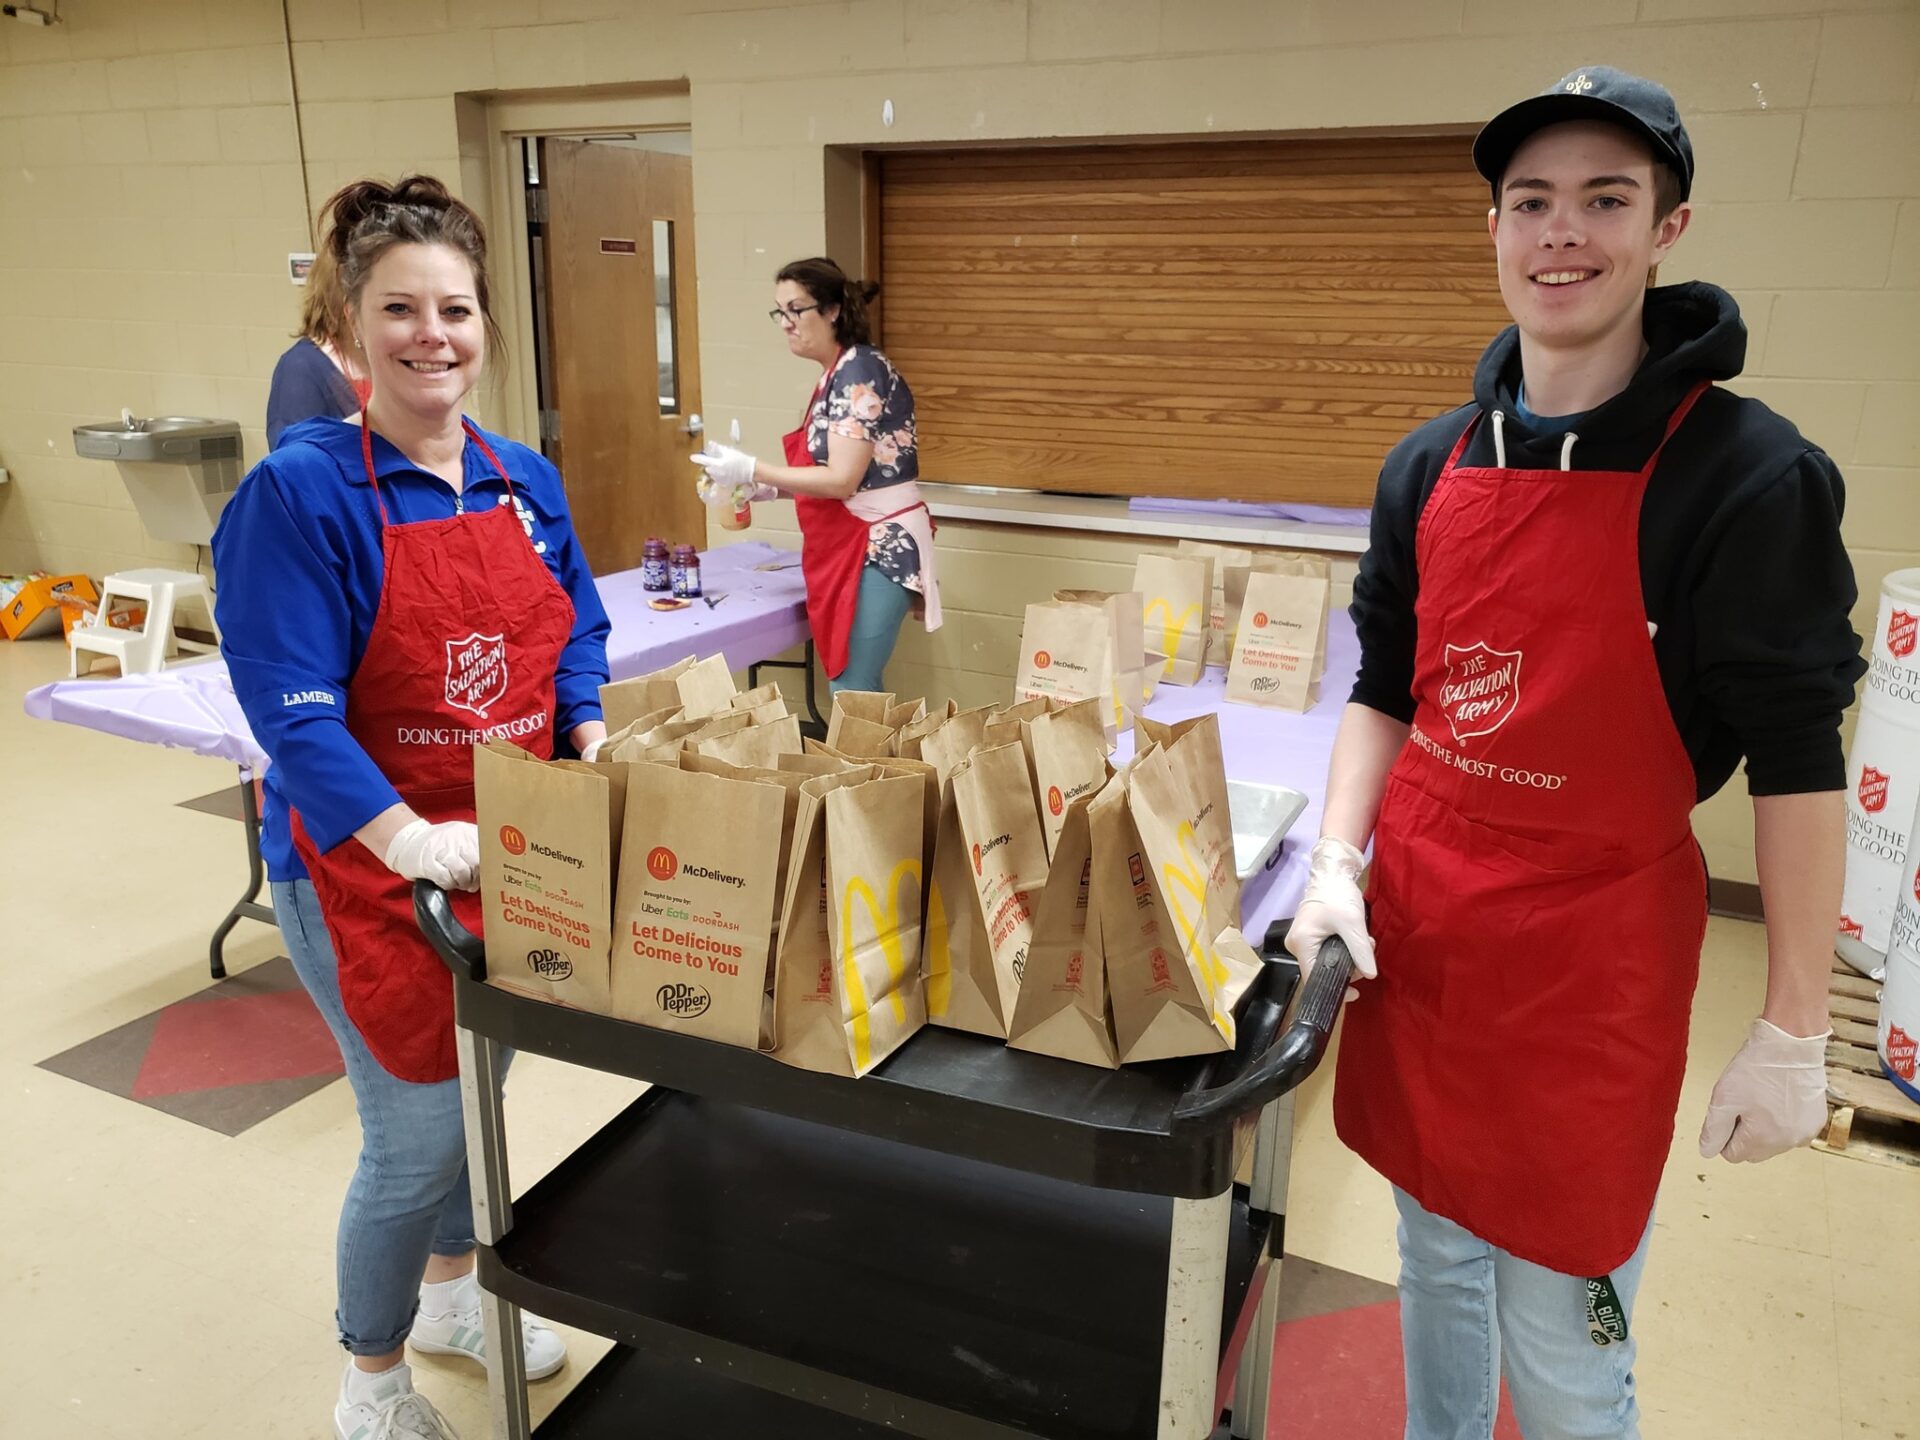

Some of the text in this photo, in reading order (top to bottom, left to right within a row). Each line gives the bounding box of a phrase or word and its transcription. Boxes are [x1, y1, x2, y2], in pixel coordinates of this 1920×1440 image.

[458, 641, 482, 670] THE
[1242, 657, 1296, 672] Come to You
[1243, 648, 1299, 662] Let Delicious
[1460, 655, 1486, 677] THE
[448, 642, 501, 698] SALVATION
[1443, 662, 1511, 707] SALVATION
[467, 665, 498, 706] ARMY
[1455, 691, 1508, 723] ARMY
[397, 728, 449, 745] DOING
[451, 728, 480, 745] THE
[1432, 741, 1452, 764] THE
[1454, 754, 1497, 778] MOST
[1876, 824, 1906, 848] THE
[643, 890, 666, 900] Brought
[666, 893, 672, 901] to
[500, 890, 591, 934] Let Delicious
[641, 902, 740, 932] Uber Eats DOORDASH
[1005, 920, 1015, 933] to
[1012, 906, 1030, 924] You
[503, 908, 591, 949] Come to You
[632, 921, 742, 958] Let Delicious
[527, 950, 570, 976] Pepper
[543, 949, 561, 962] Dr
[633, 940, 739, 976] Come to You
[657, 984, 707, 1013] Pepper
[676, 983, 695, 998] Dr
